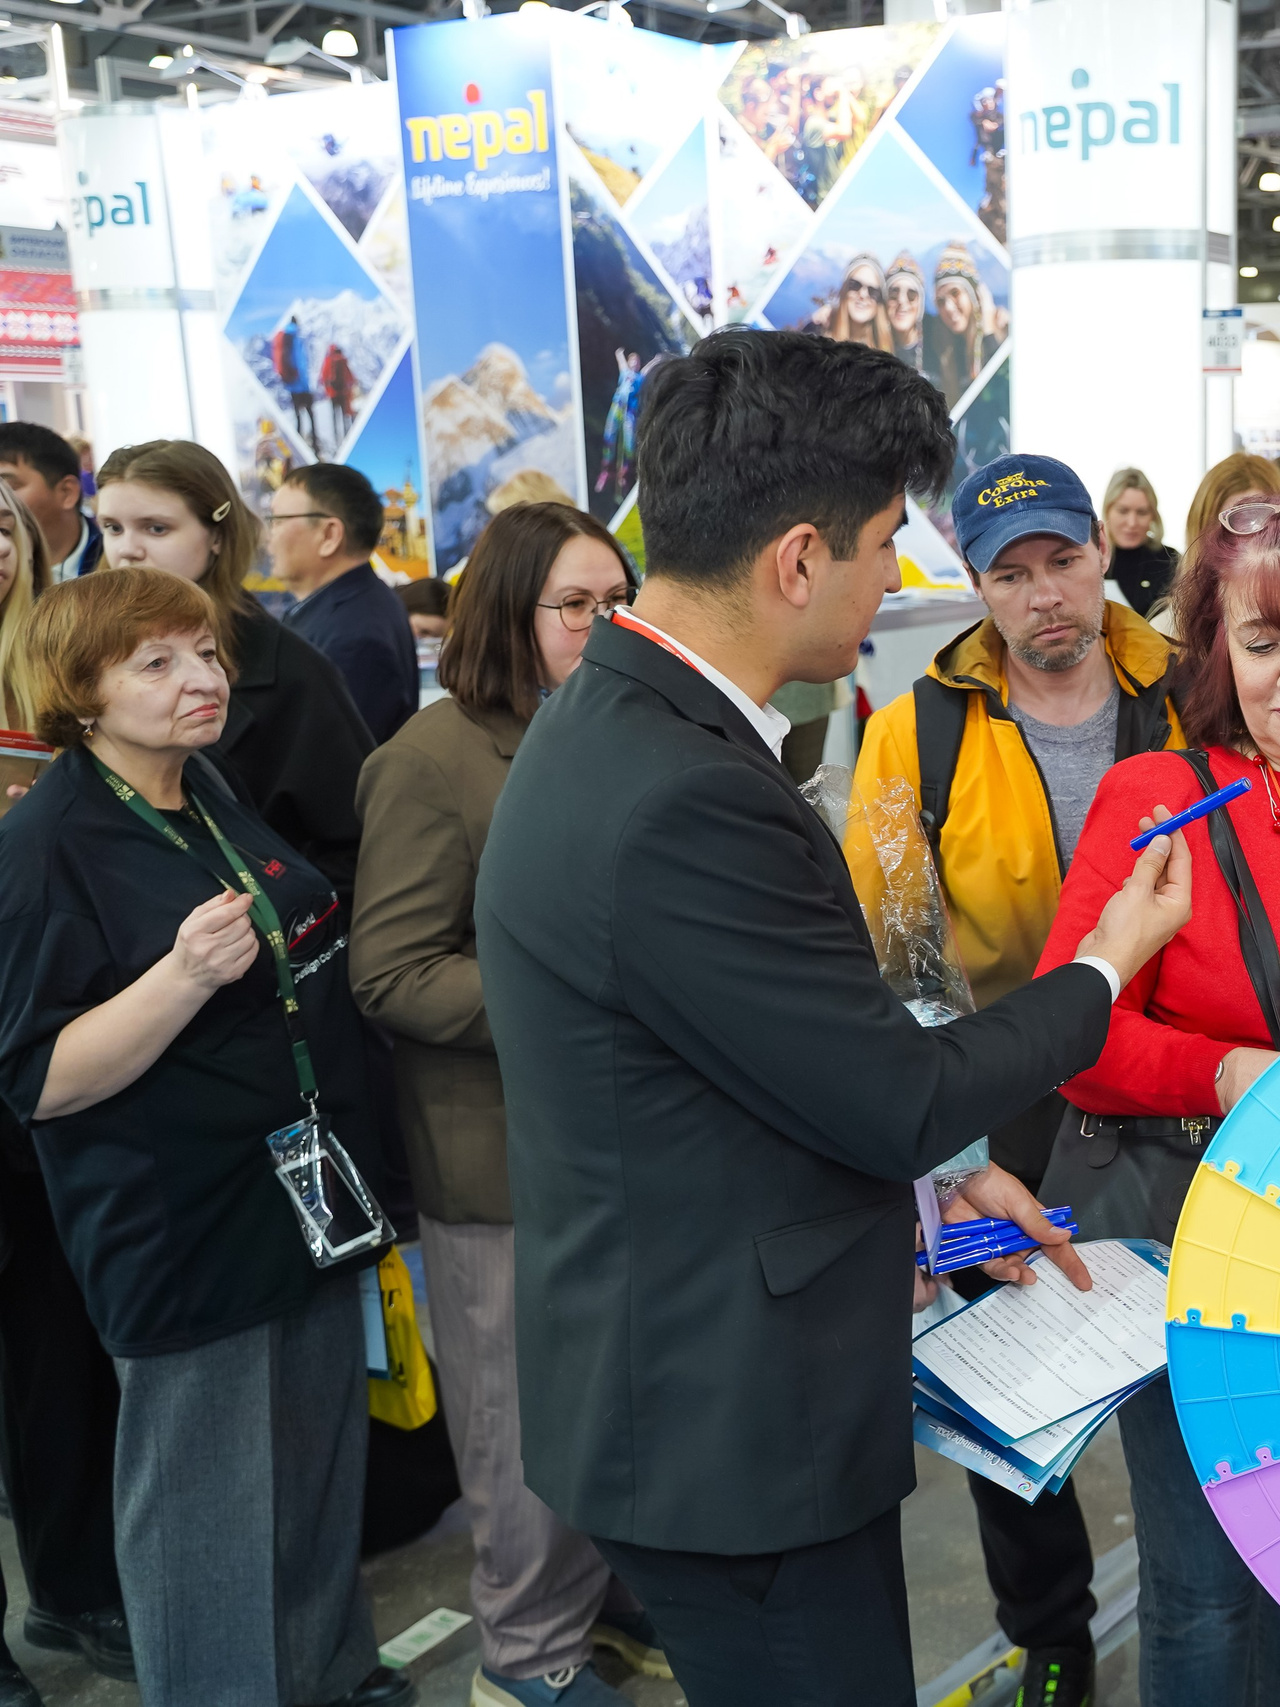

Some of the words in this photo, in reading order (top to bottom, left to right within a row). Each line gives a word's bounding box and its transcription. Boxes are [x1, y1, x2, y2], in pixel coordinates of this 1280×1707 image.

[405, 86, 549, 171] nepal
[1019, 82, 1180, 161] nepal
[977, 477, 1049, 506] Corona
[993, 488, 1038, 508] Extra
